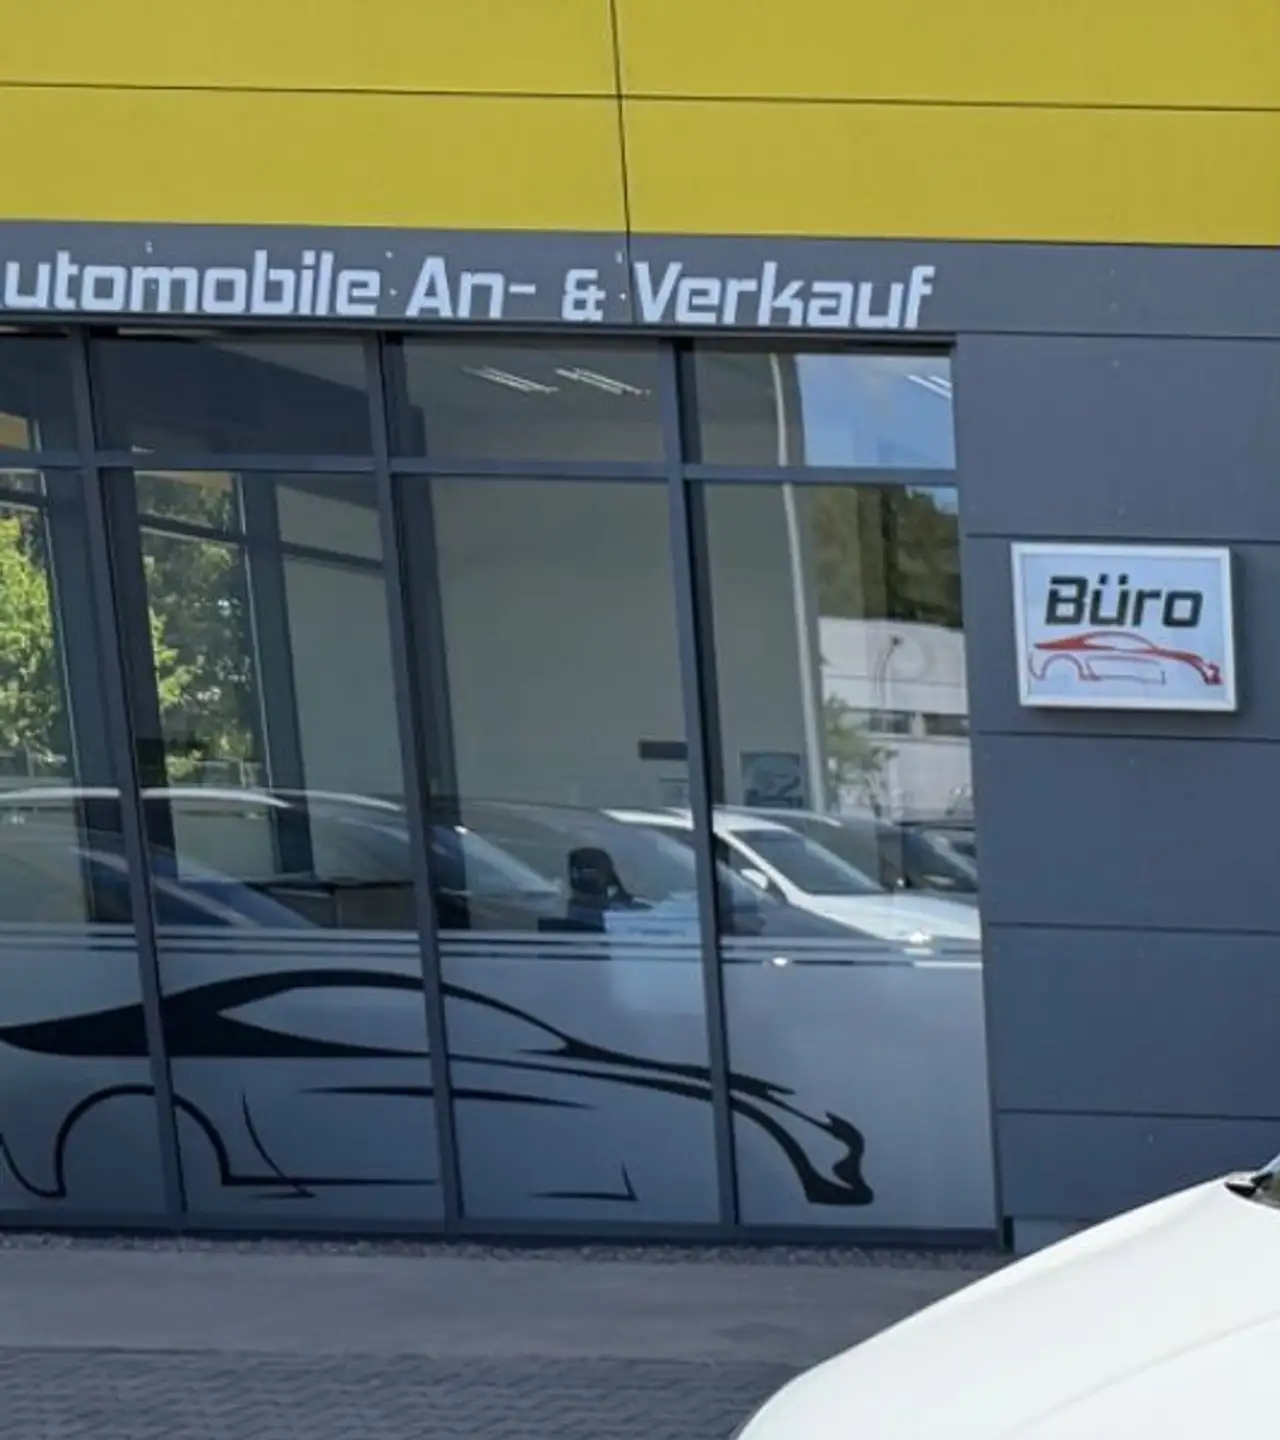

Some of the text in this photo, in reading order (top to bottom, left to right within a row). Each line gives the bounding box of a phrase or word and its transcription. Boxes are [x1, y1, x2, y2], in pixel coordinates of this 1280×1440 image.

[0, 249, 936, 330] utomobile An- & Verkauf
[1045, 573, 1203, 627] Büro
